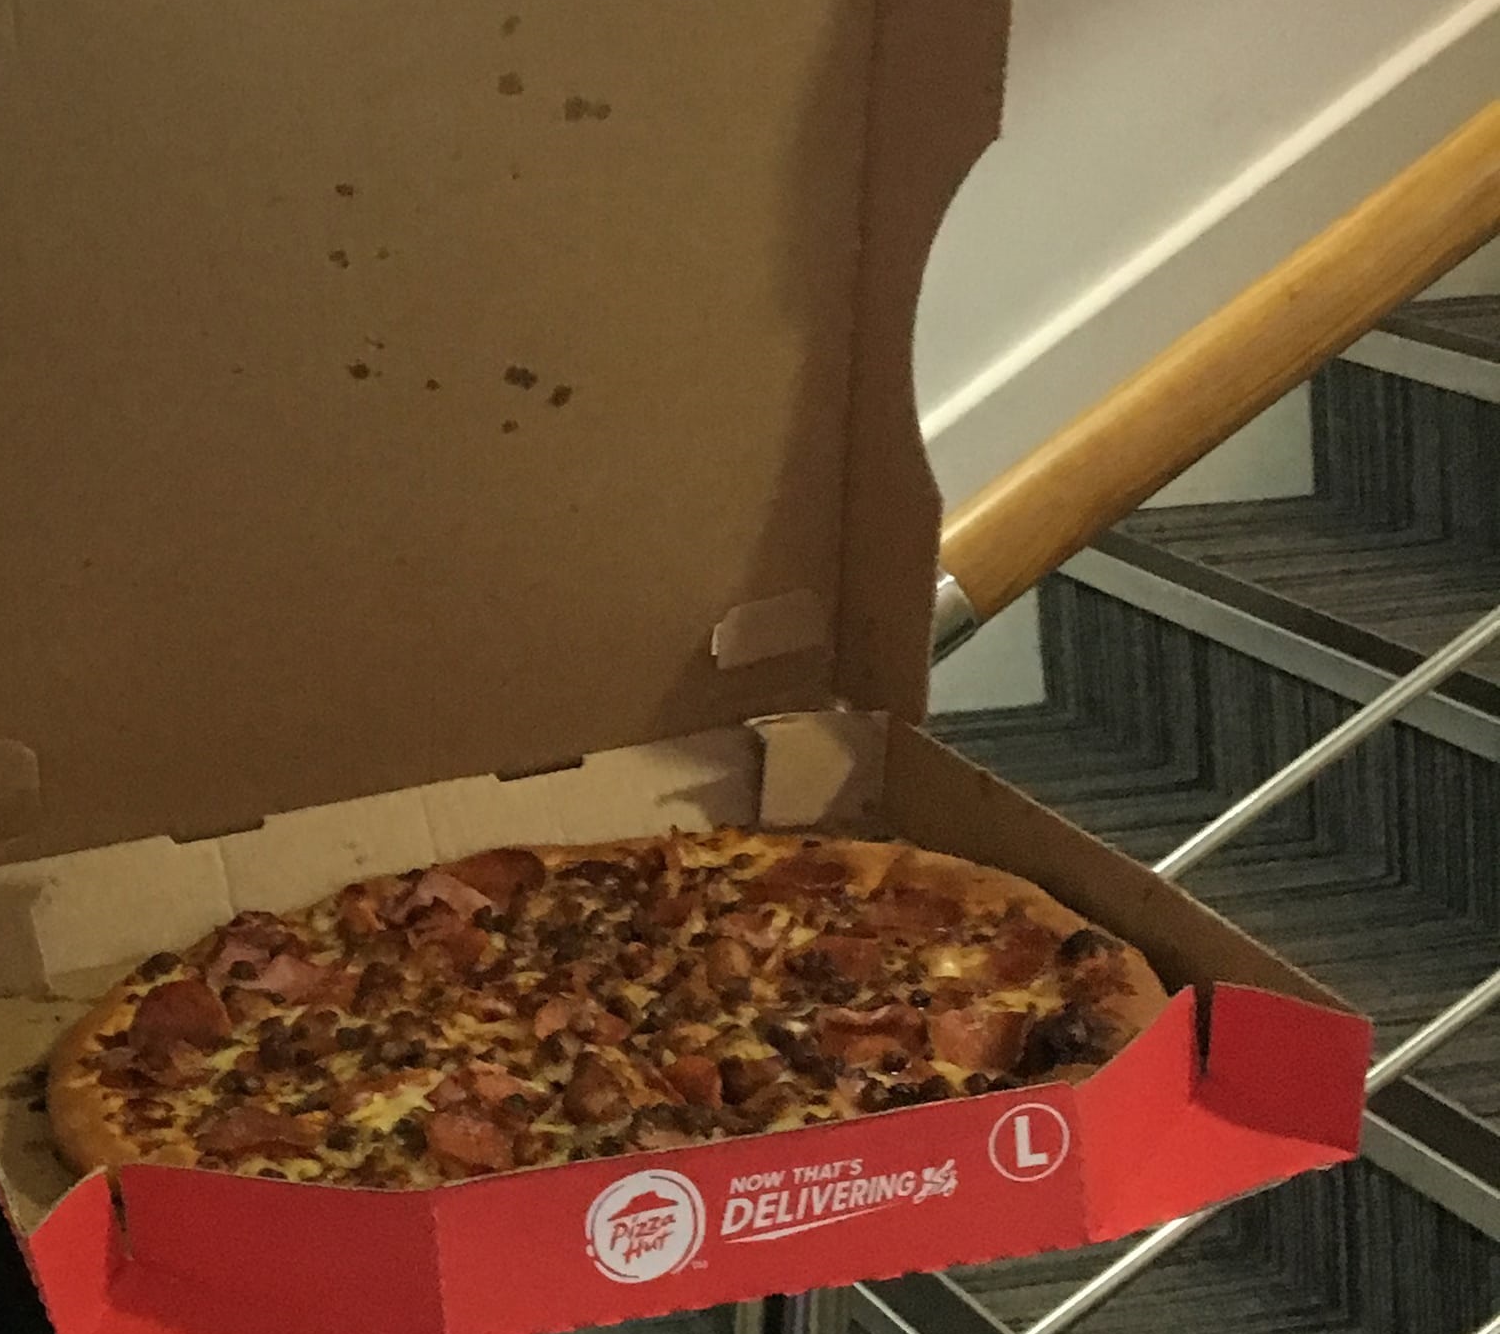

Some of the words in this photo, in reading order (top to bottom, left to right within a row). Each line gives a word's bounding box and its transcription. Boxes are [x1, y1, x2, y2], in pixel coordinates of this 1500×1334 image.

[1015, 1115, 1048, 1168] L
[729, 1170, 786, 1195] NOW
[792, 1158, 864, 1185] THAT'S
[720, 1170, 916, 1236] DELIVERING
[609, 1214, 677, 1251] Pizza
[622, 1231, 675, 1264] Hut
